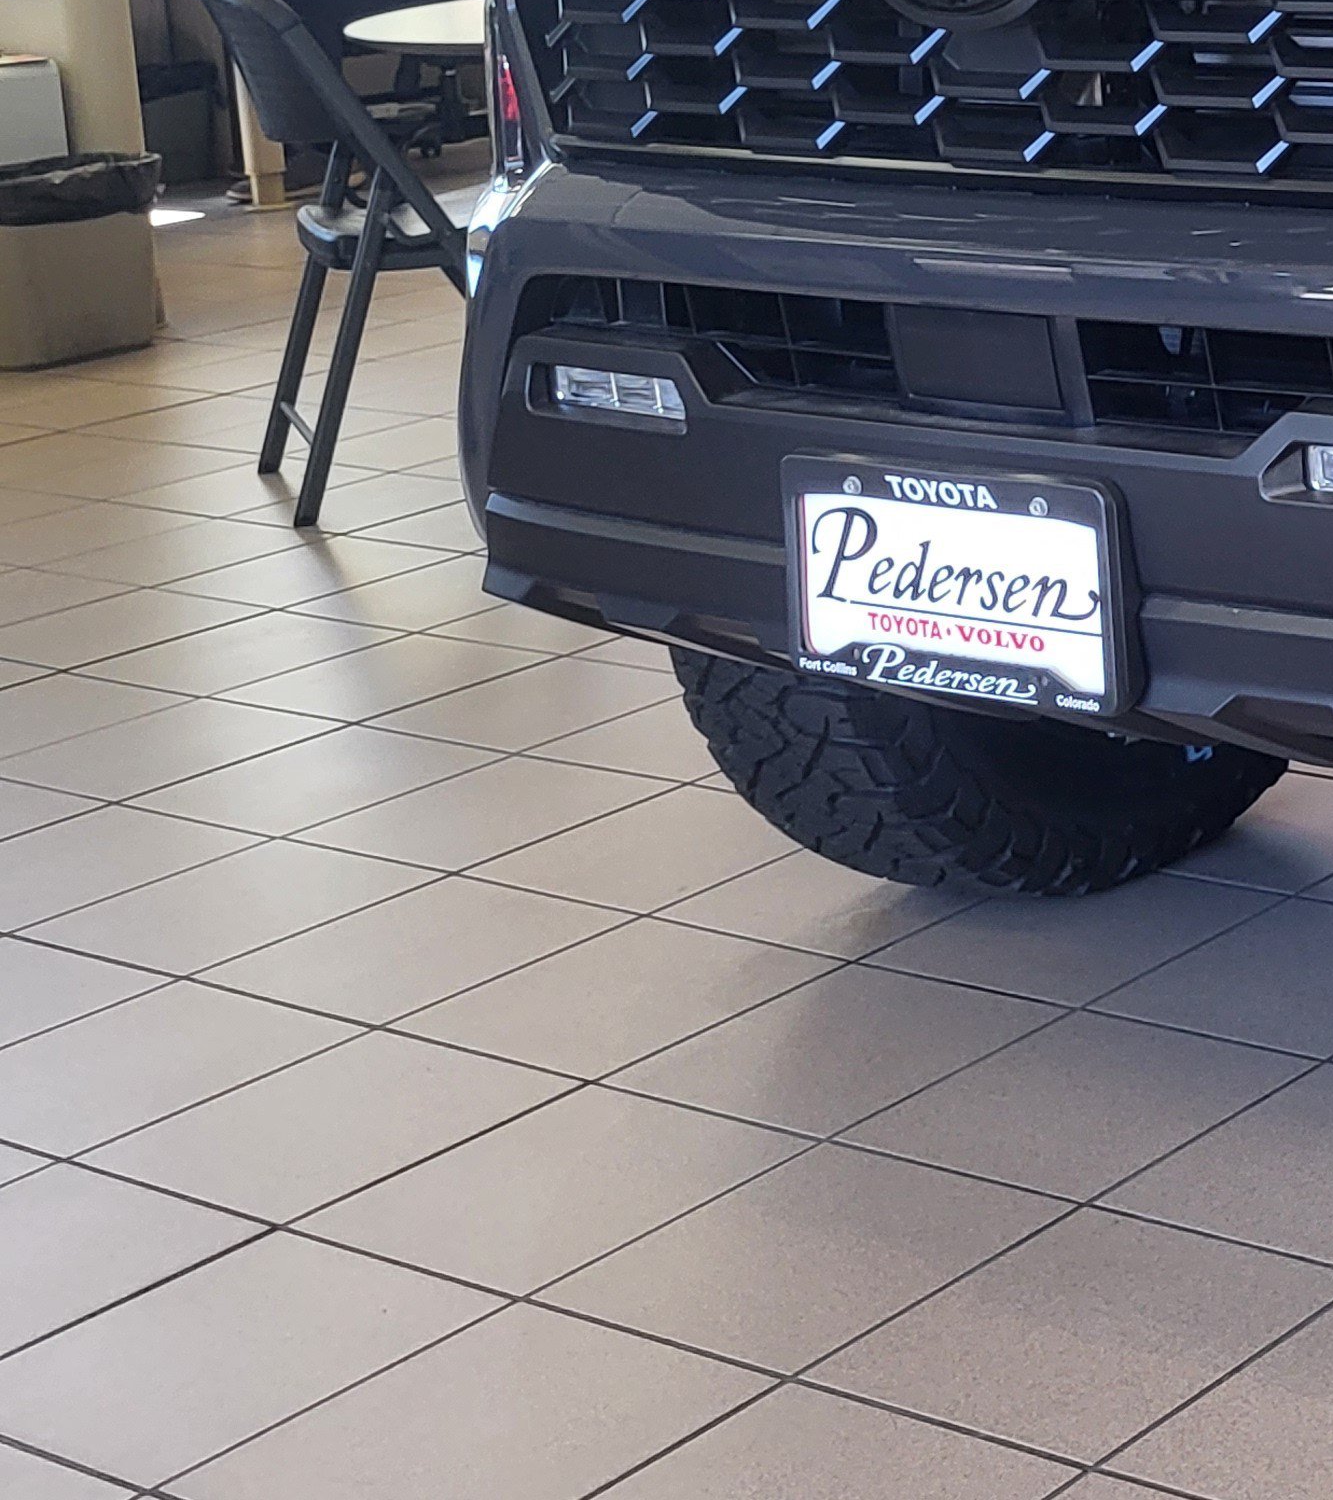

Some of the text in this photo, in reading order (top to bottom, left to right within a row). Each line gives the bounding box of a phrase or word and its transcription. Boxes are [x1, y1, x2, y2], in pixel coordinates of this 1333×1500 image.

[884, 475, 998, 509] TOYOTA
[812, 507, 1101, 621] Pedersen
[868, 612, 1045, 652] TOYOTA VOLVO
[799, 657, 857, 677] Fort Collins
[862, 643, 1037, 698] Pedersen
[1055, 694, 1100, 712] Colorado
